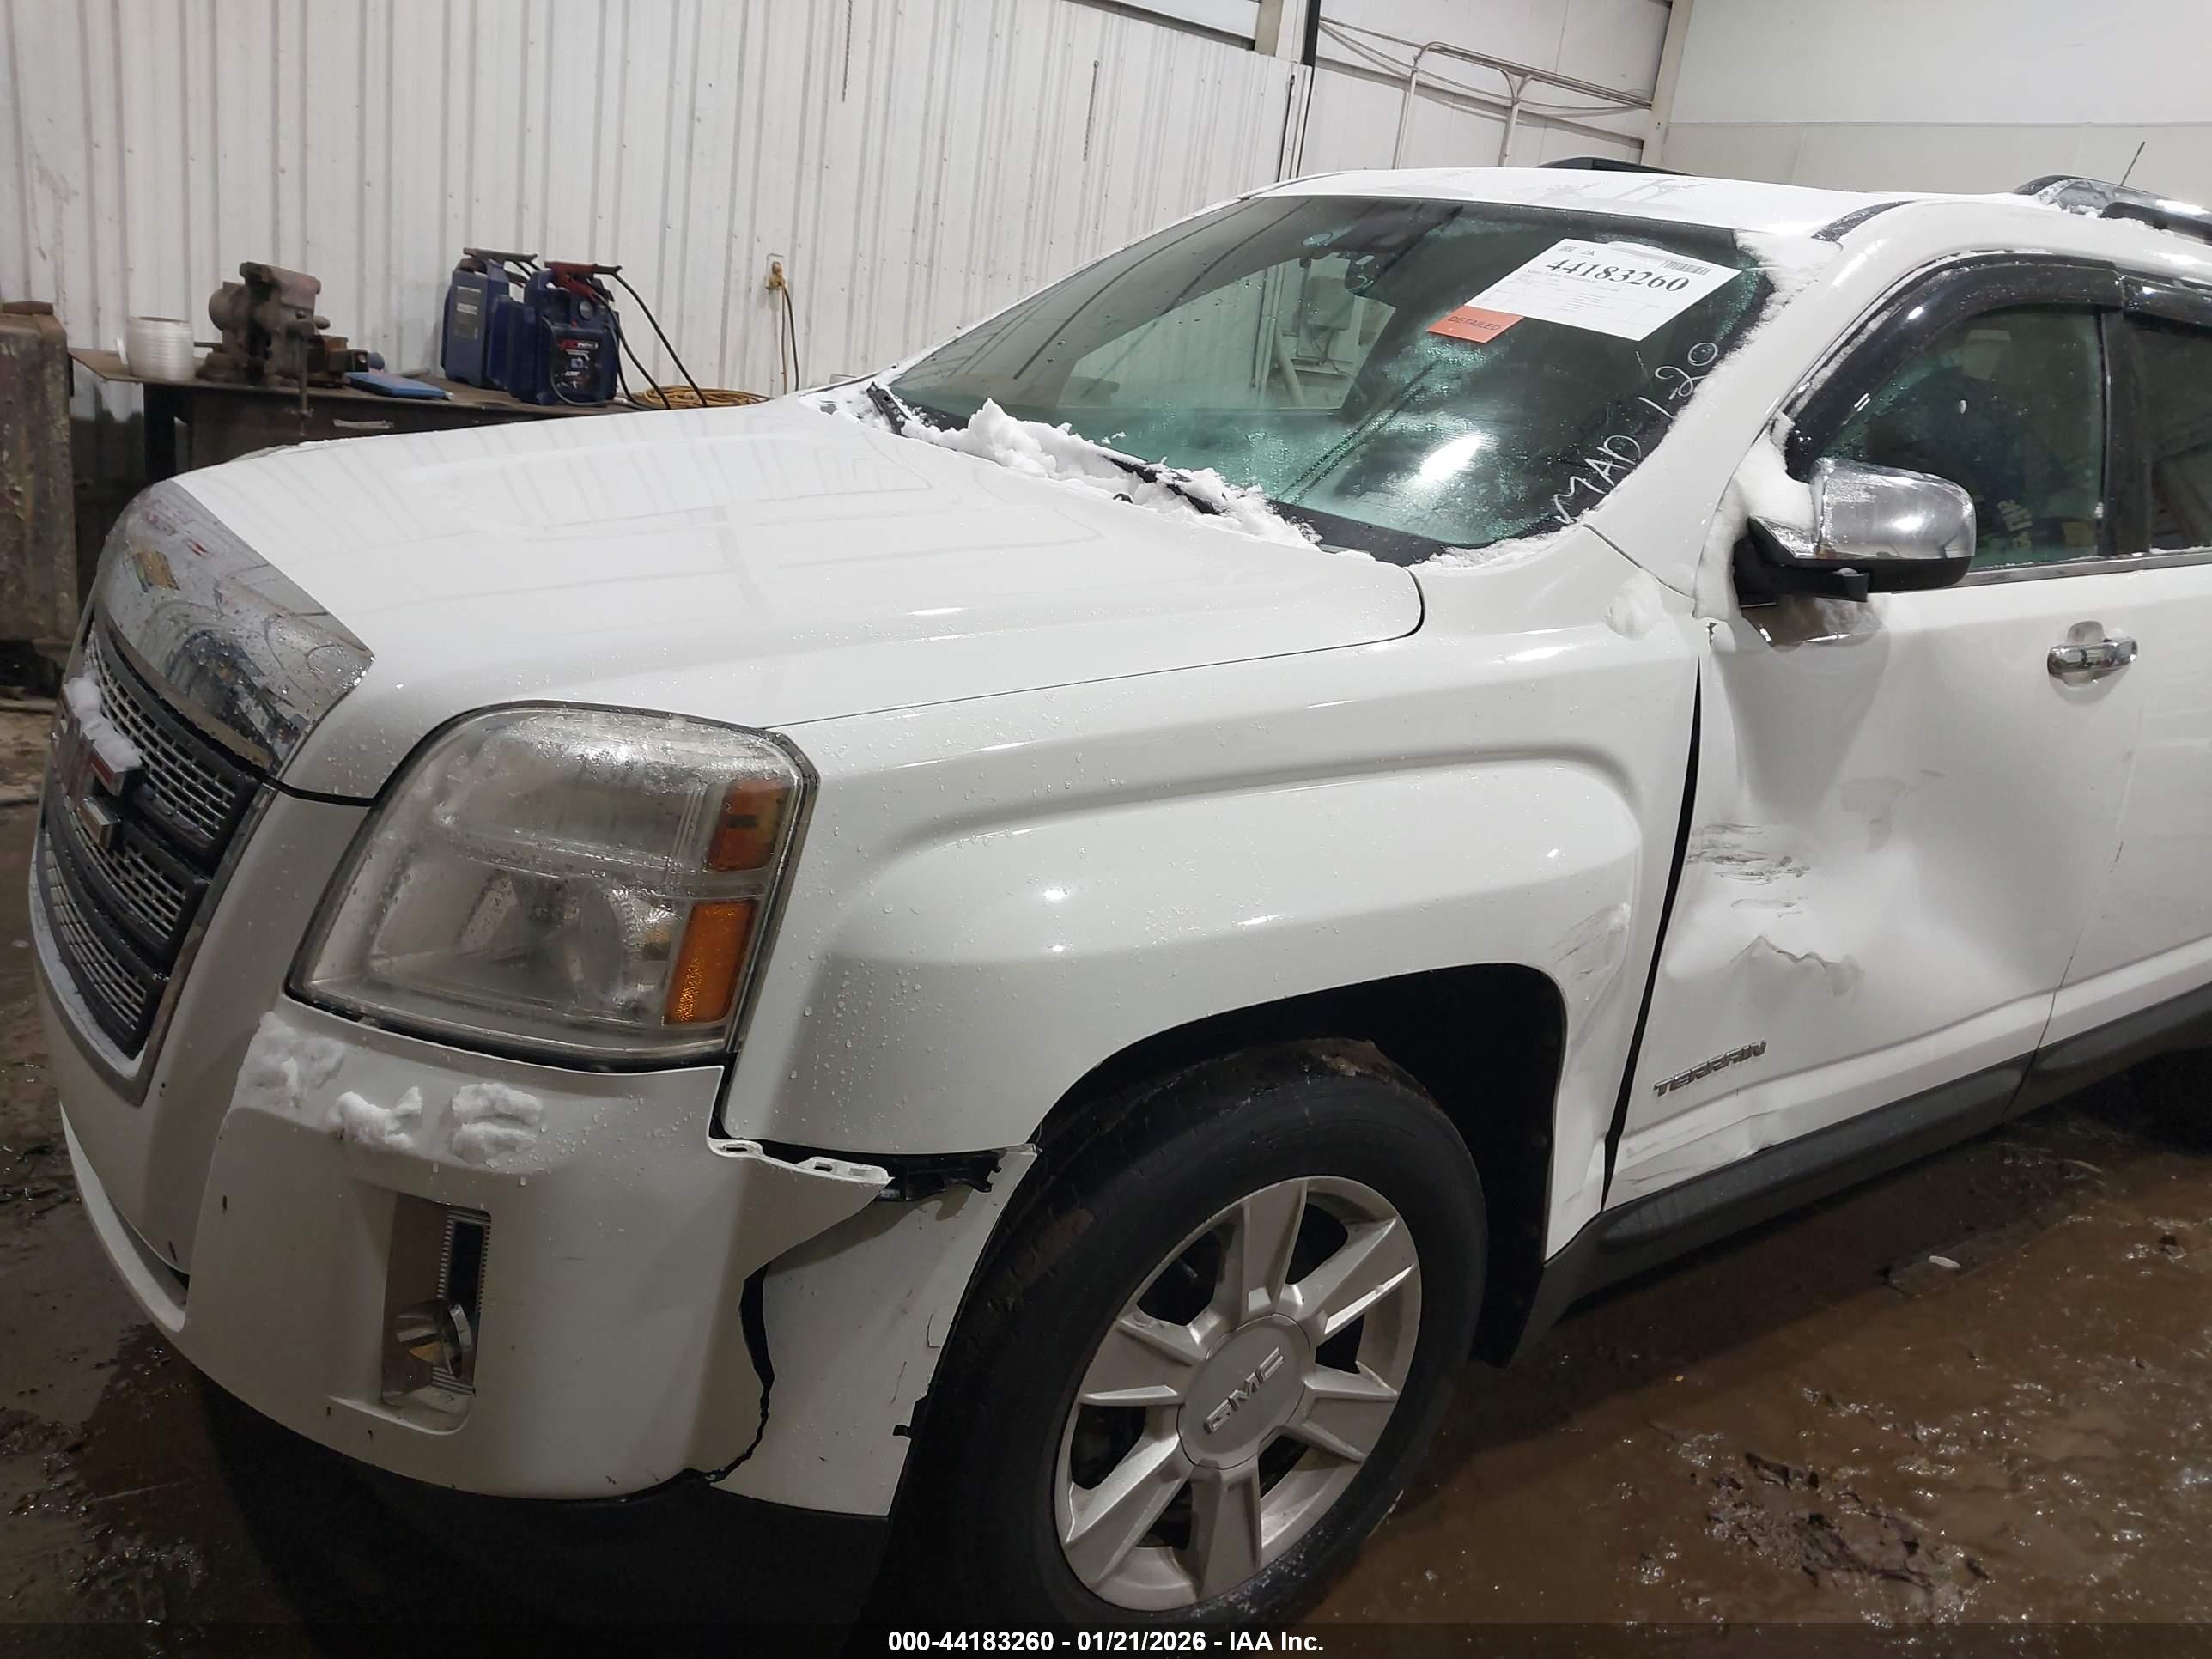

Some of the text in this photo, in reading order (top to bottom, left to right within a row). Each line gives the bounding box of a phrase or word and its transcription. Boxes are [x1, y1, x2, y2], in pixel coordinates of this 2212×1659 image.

[1546, 259, 1690, 291] 44183260
[1448, 315, 1501, 331] DETAILED
[1553, 342, 1717, 524] MAD 1-20
[1203, 1346, 1285, 1435] GMC
